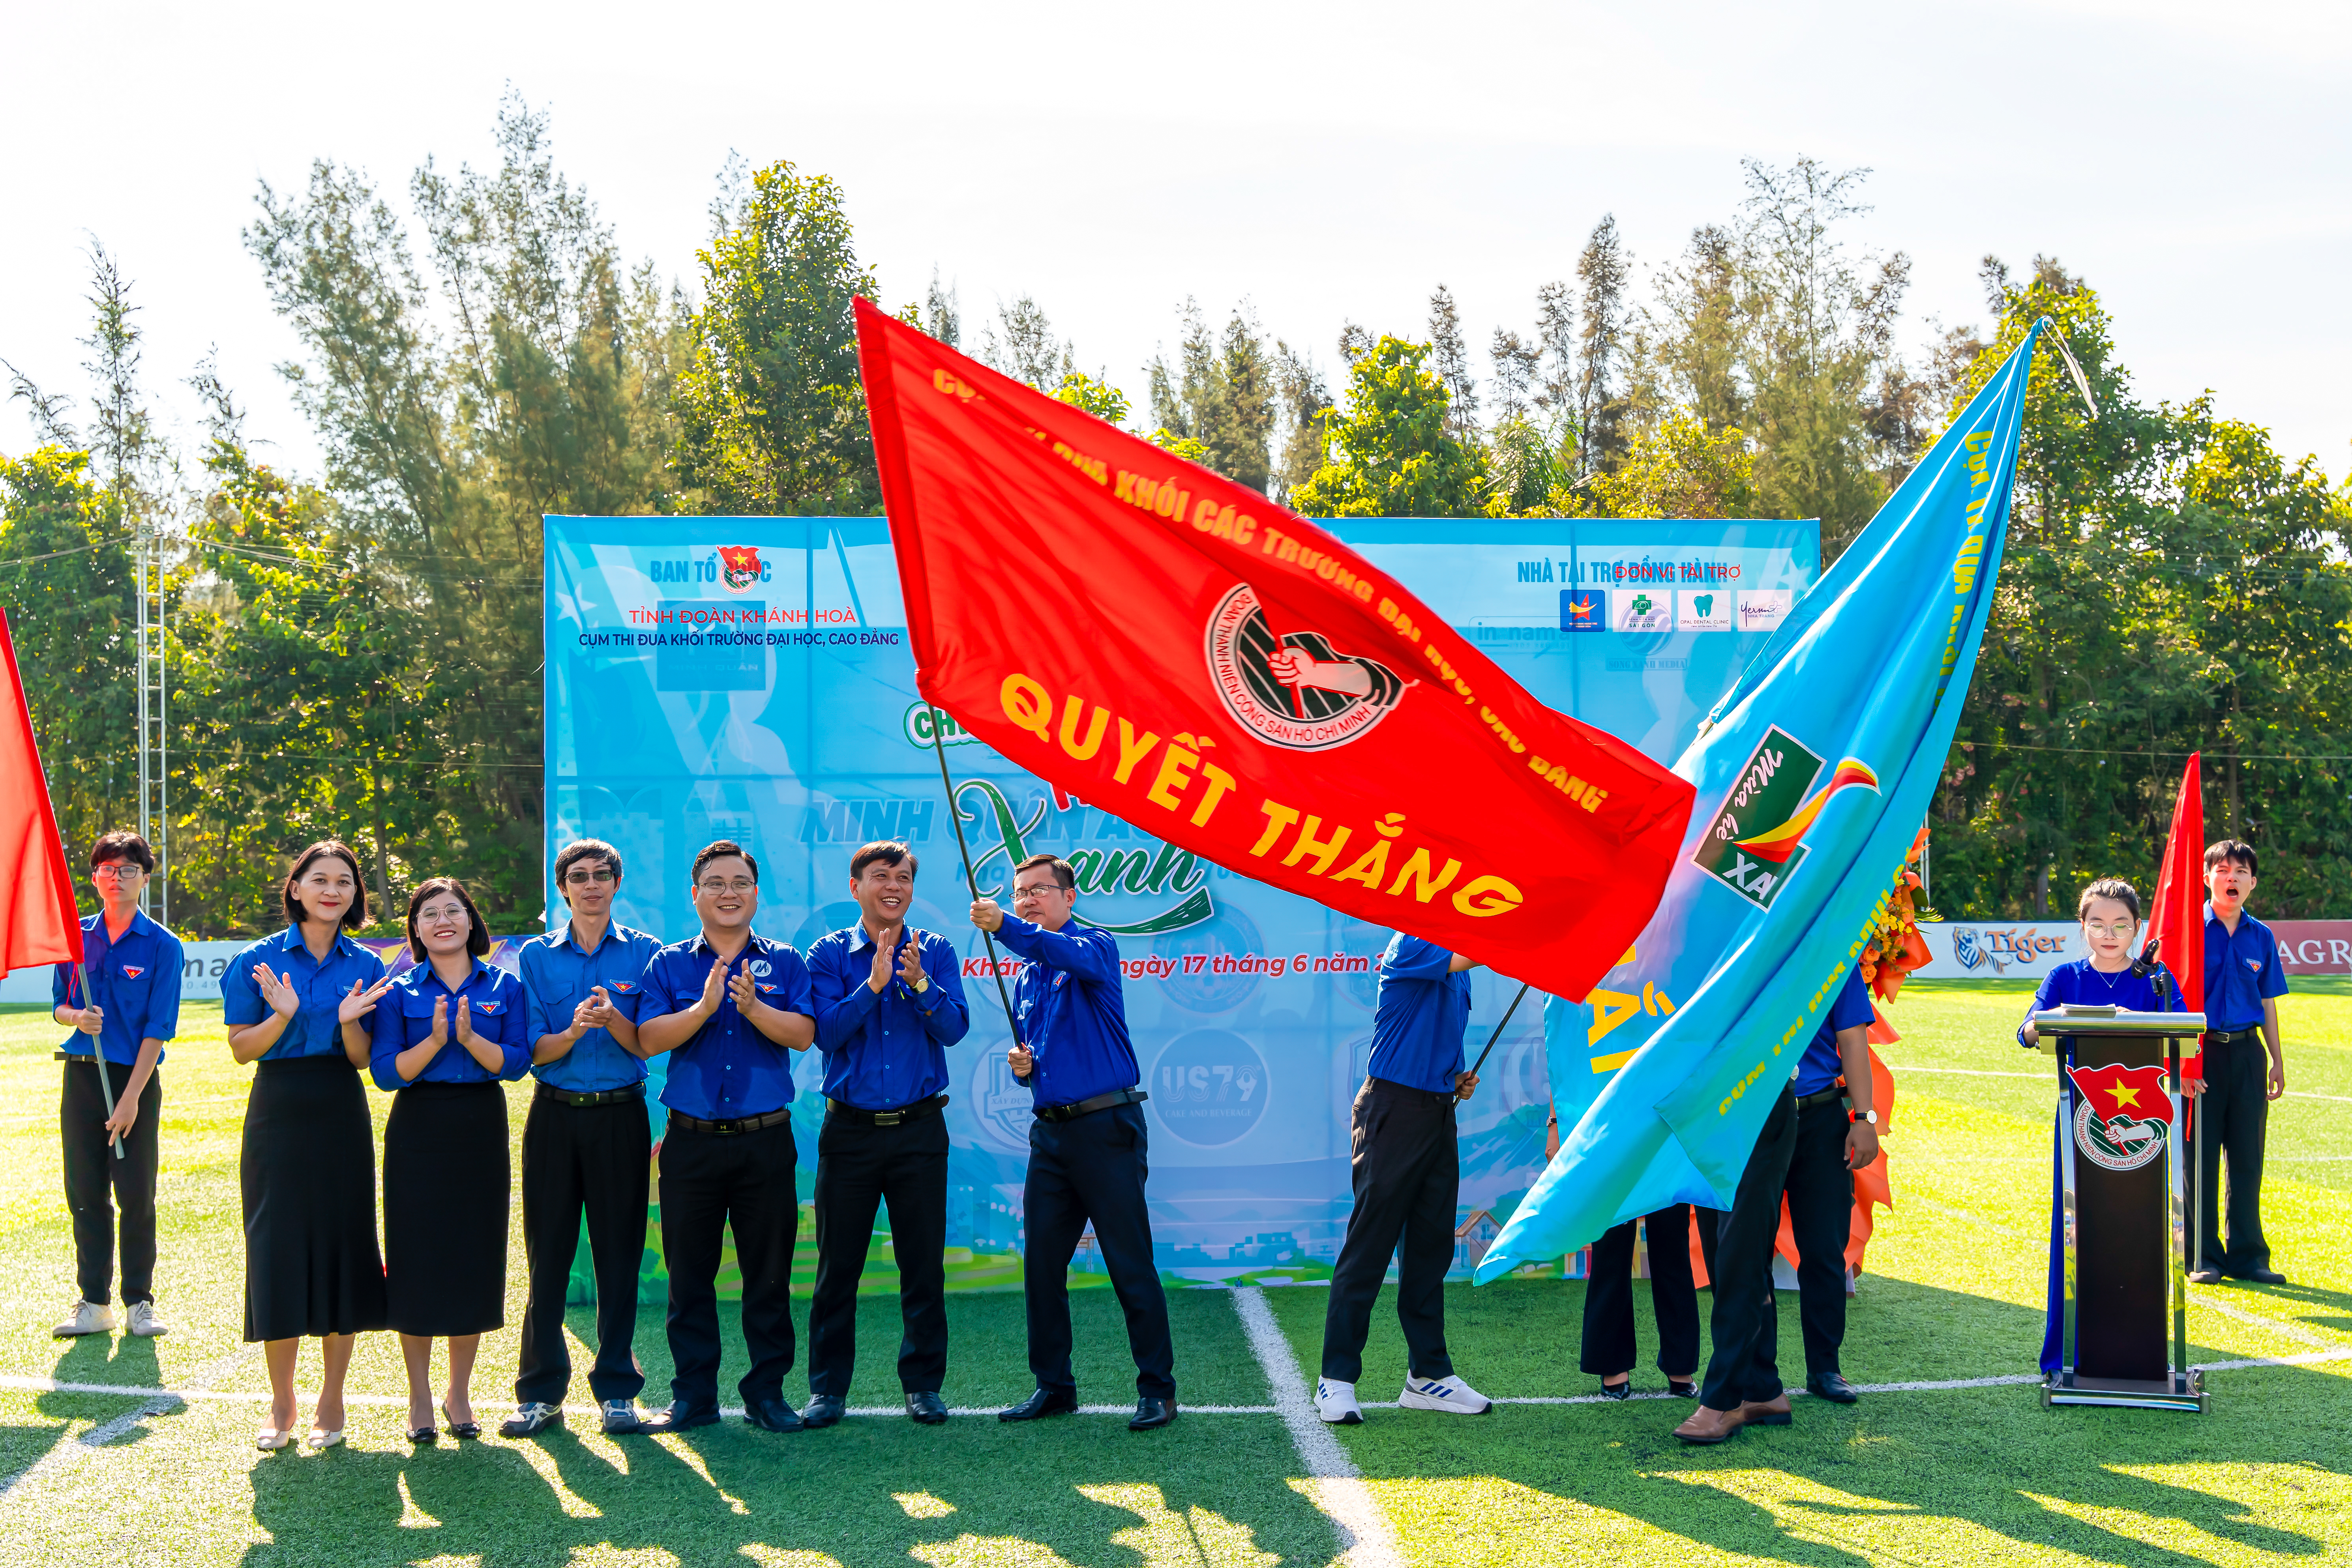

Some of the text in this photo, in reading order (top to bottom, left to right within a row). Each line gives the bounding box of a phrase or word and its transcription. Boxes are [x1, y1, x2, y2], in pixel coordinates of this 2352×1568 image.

[1113, 476, 1190, 522] KHỐI
[1193, 499, 1258, 544] CÁC
[650, 560, 688, 582] BAN
[694, 553, 717, 582] TỔ
[1518, 558, 1554, 582] NHÀ
[1591, 560, 1623, 587] TRỢ
[1615, 563, 1741, 581] ĐƠN VỊ TÀI TRỢ
[629, 606, 856, 623] TỈNH ĐOÀN KHÁNH HOÀ
[579, 628, 899, 649] CỤM THI ĐUA KHỐI TRƯỜNG ĐẠI HỌC, CAO ĐẲNG
[1215, 624, 1234, 662] THANH
[1218, 663, 1240, 694] NIÊN
[1234, 693, 1266, 727] CỘNG
[1341, 706, 1372, 733] MINH
[1265, 720, 1292, 739] SẢN
[1294, 725, 1313, 741] HỒ
[1315, 721, 1339, 739] CHÍ
[999, 673, 1524, 917] QUYẾT THẮNG
[1716, 748, 1783, 840] Mùa hè
[800, 800, 935, 843] MINH
[1985, 928, 2067, 963] Tiger
[1184, 956, 1207, 974] 17
[1212, 954, 1286, 978] tháng
[1293, 954, 1308, 973] 6
[1314, 953, 1368, 972] năm
[1162, 1065, 1258, 1102] US79
[1165, 1108, 1252, 1118] CAKE AND BEVERAGE
[2079, 1105, 2091, 1120] ĐOÀN
[2078, 1122, 2087, 1142] THANH
[2083, 1141, 2096, 1156] NIÊN
[2094, 1153, 2112, 1165] CỘNG
[2136, 1152, 2148, 1163] CHÍ
[2146, 1141, 2159, 1156] MINH
